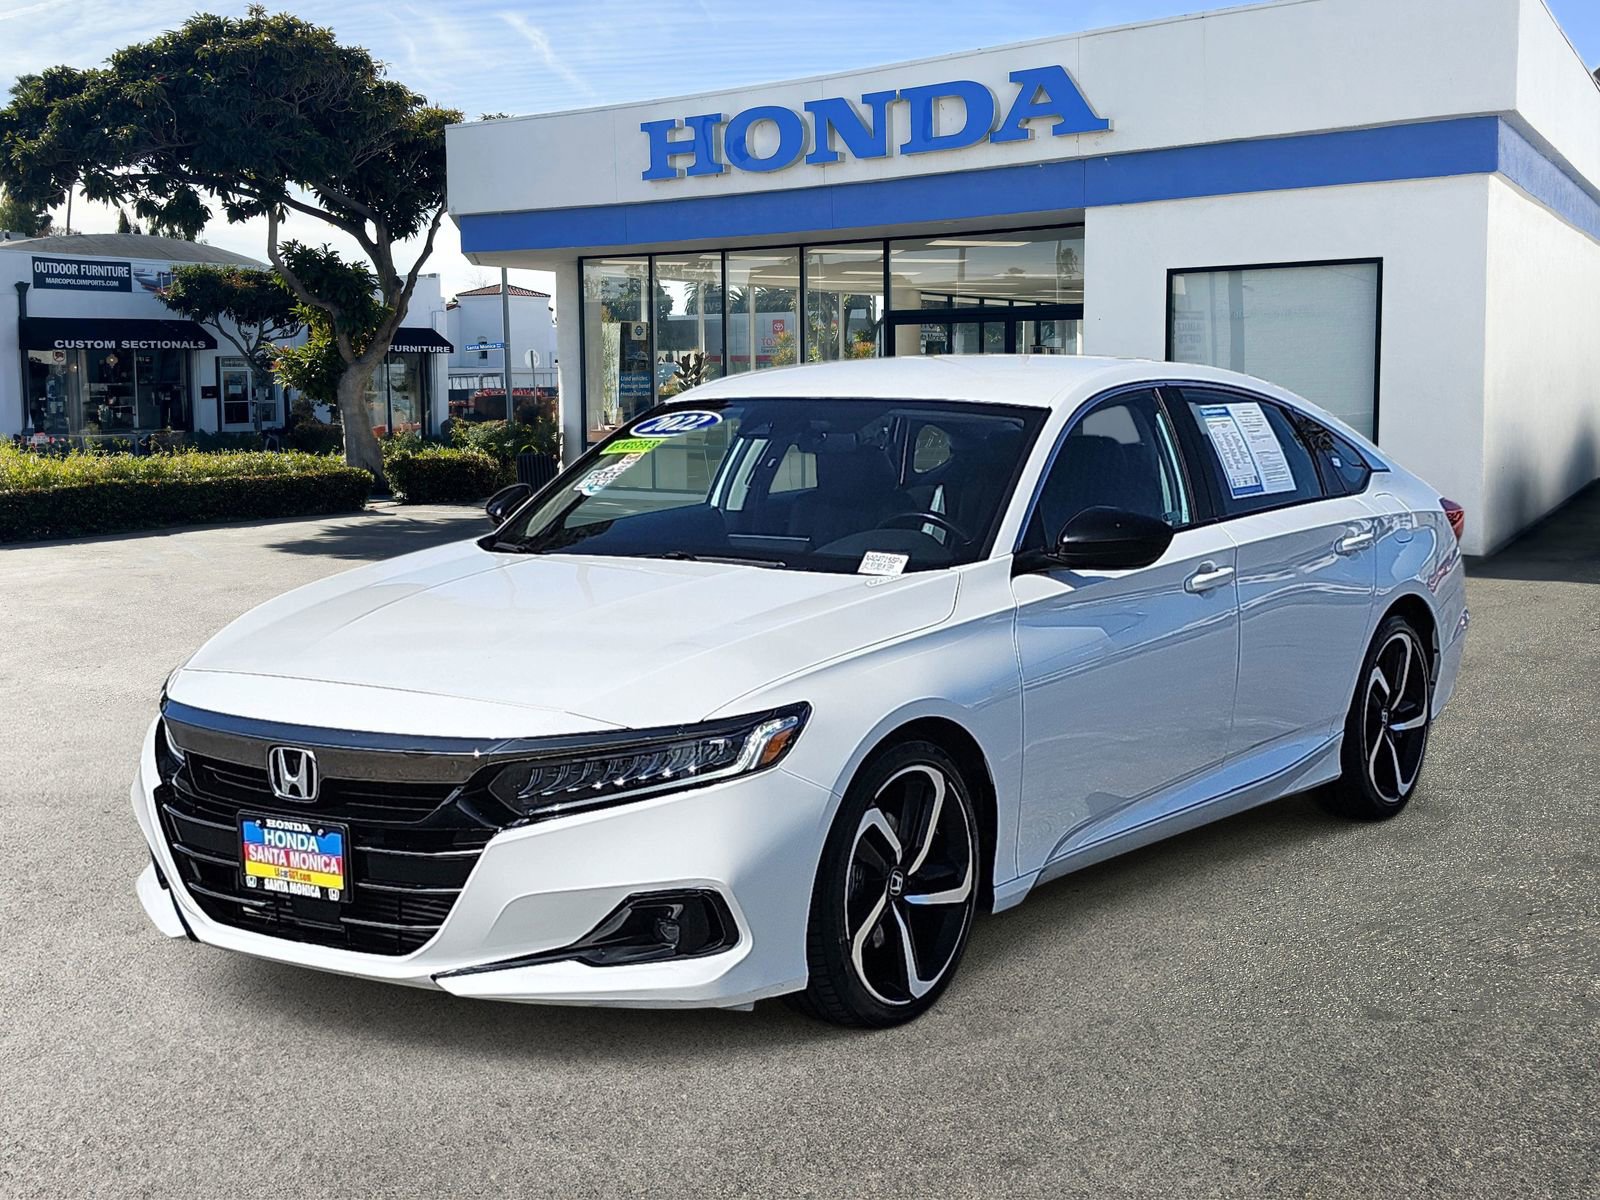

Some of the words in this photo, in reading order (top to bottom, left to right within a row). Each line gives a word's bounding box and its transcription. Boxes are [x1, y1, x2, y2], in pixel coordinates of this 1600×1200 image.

[640, 64, 1113, 182] HONDA
[34, 261, 79, 275] OUTDOOR
[80, 264, 130, 278] FURNITURE
[45, 277, 119, 287] MARCOPOLOIMPORTS.COM
[54, 340, 116, 349] CUSTOM
[121, 340, 206, 349] SECTIONALS
[388, 344, 450, 353] FURNITURE
[643, 414, 710, 432] 2022
[265, 818, 313, 833] HONDA
[263, 829, 320, 853] HONDA
[248, 844, 288, 867] SANTA
[289, 850, 339, 874] MONICA
[264, 878, 289, 893] SANTA
[289, 881, 321, 899] MONICA
